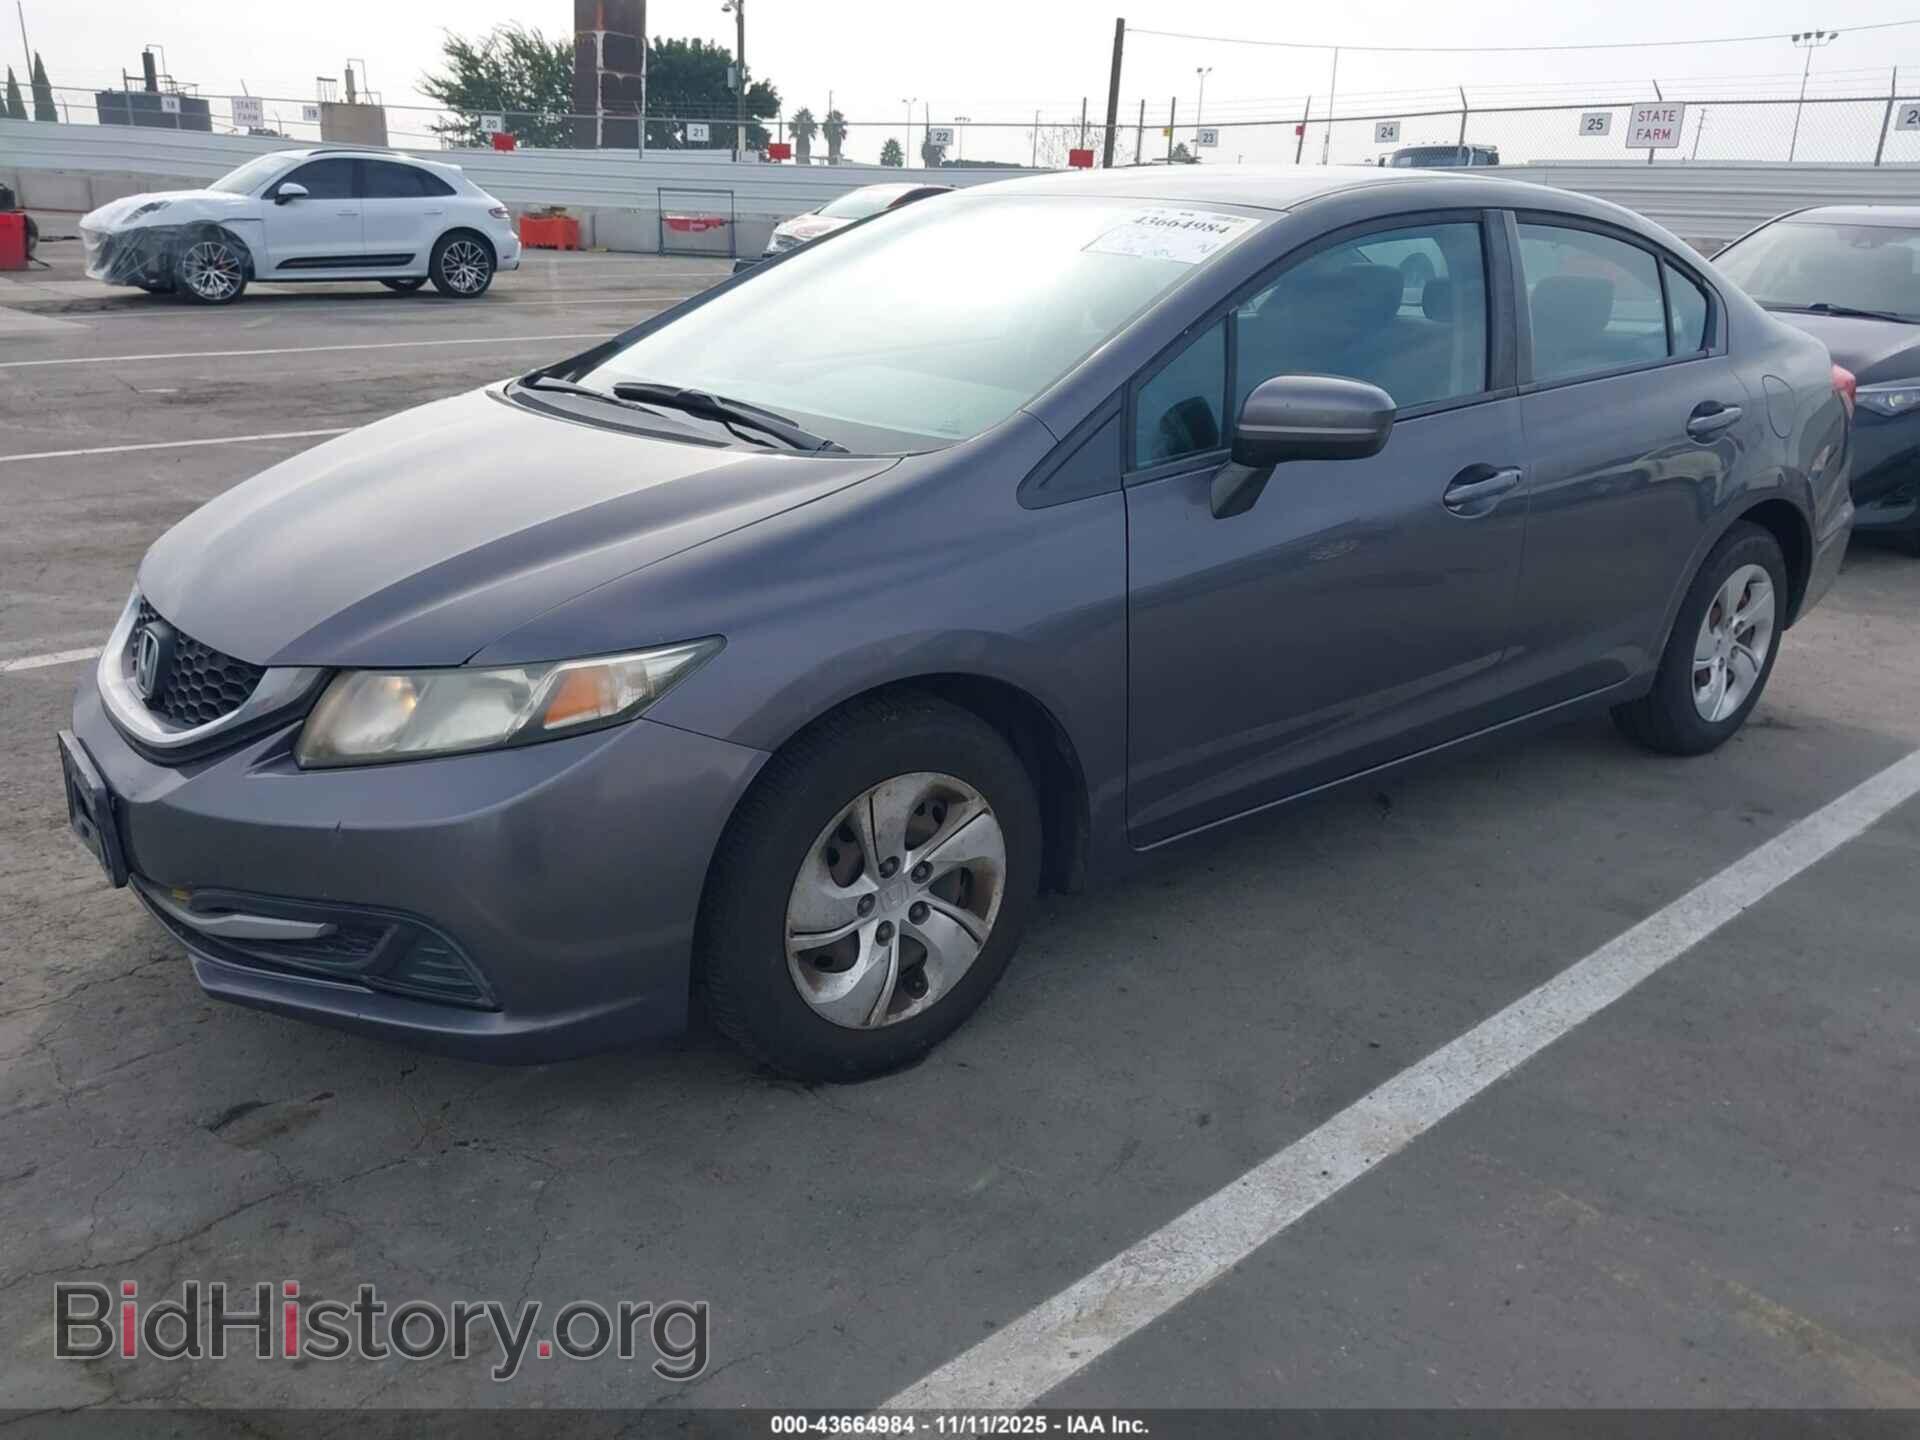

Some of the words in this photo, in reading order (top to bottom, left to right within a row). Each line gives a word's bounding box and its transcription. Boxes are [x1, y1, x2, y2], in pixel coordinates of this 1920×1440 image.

[236, 100, 258, 111] STATE
[238, 113, 258, 121] FARM
[1638, 110, 1677, 122] STATE
[1906, 110, 1920, 124] 2
[486, 119, 497, 129] 20
[1587, 118, 1604, 130] 25
[693, 127, 704, 137] 21
[936, 132, 949, 142] 22
[1381, 127, 1394, 138] 24
[1636, 128, 1672, 140] FARM
[1203, 132, 1214, 144] 23
